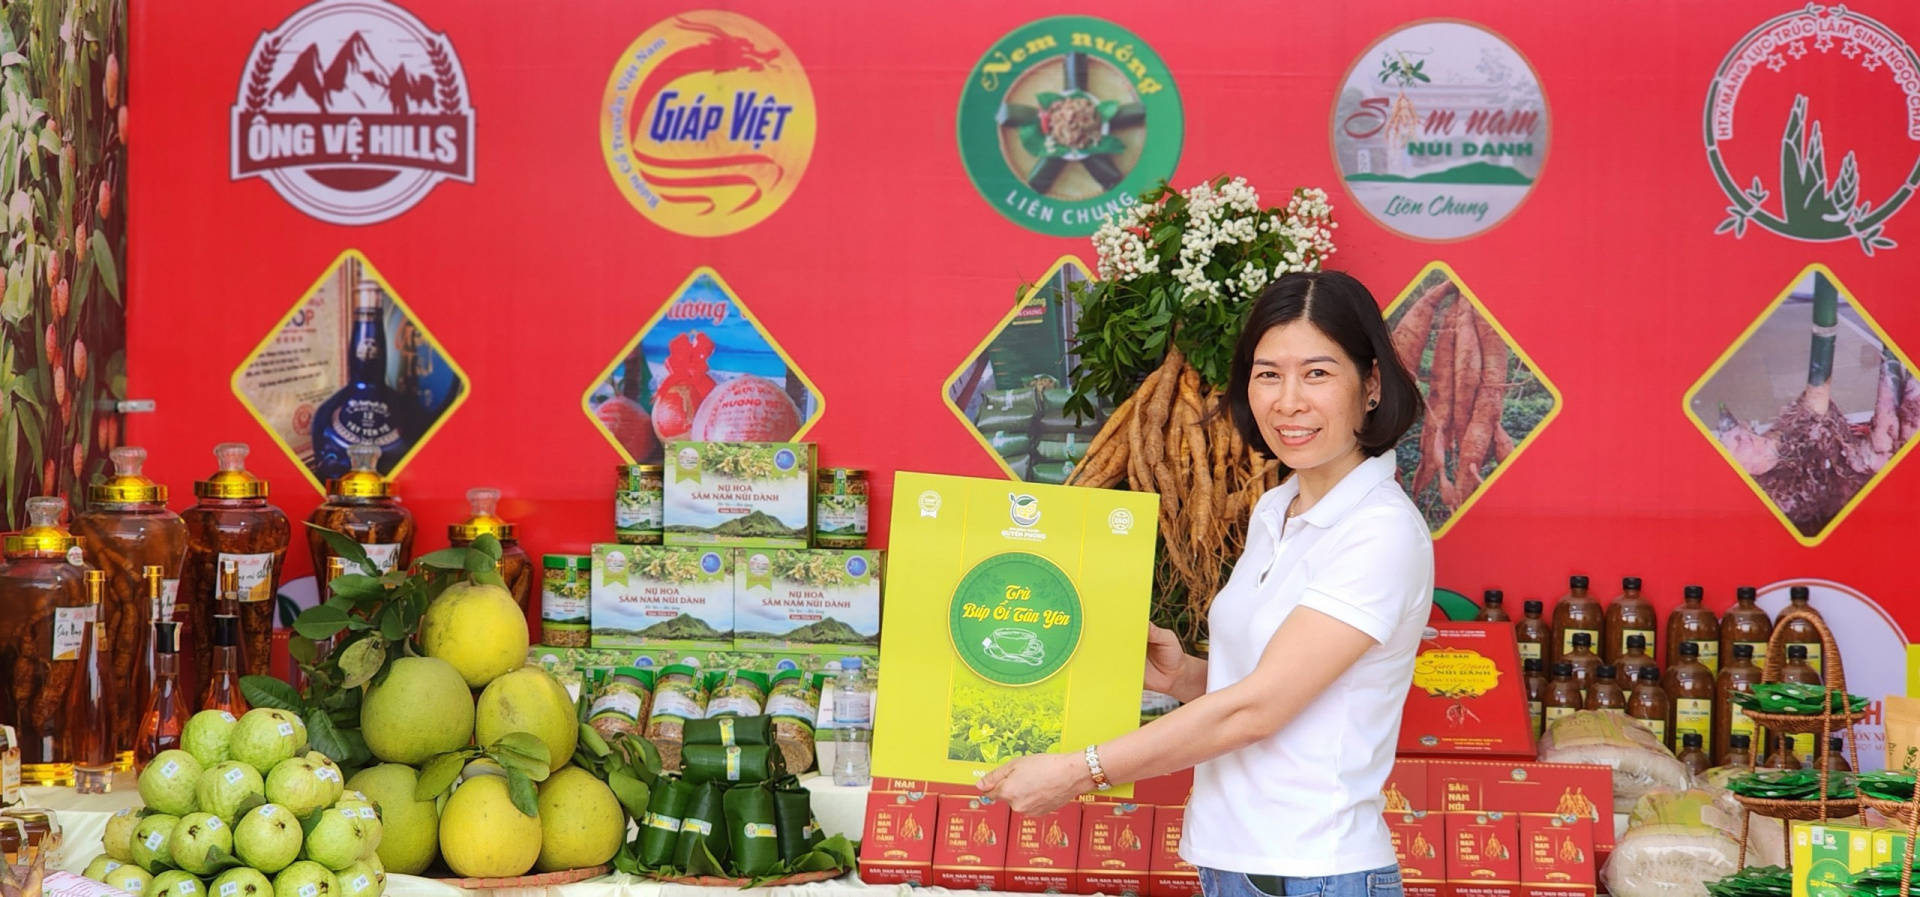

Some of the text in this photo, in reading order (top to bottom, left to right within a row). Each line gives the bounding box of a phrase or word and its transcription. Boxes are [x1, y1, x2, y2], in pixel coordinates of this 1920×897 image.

[617, 64, 639, 92] Việt
[636, 38, 666, 65] Nam
[981, 32, 1163, 94] Nem nướng
[1718, 108, 1730, 136] HTX
[1775, 19, 1813, 42] TRÚC
[1819, 18, 1851, 35] LÂM
[1854, 28, 1887, 52] SINH
[1887, 51, 1918, 92] NGỌC
[649, 91, 793, 150] GIÁP VIỆT
[1466, 110, 1539, 135] nam
[248, 115, 458, 163] ÔNG VỆ HILLS
[1006, 189, 1135, 224] LIÊN CHUNG
[1383, 195, 1489, 222] Liên Chung
[691, 491, 779, 502] SÂM NAM NÚI DÀNH
[733, 485, 752, 493] HOA
[619, 594, 638, 603] SÂM
[662, 595, 678, 604] NÚI
[680, 596, 705, 605] DÀNH
[762, 598, 851, 608] SÂM NAM NÚI DÀNH
[1005, 585, 1031, 600] Trà
[962, 600, 1071, 629] Búp Ổi Tân Yên
[894, 780, 915, 788] NAM
[1448, 794, 1470, 802] NAM
